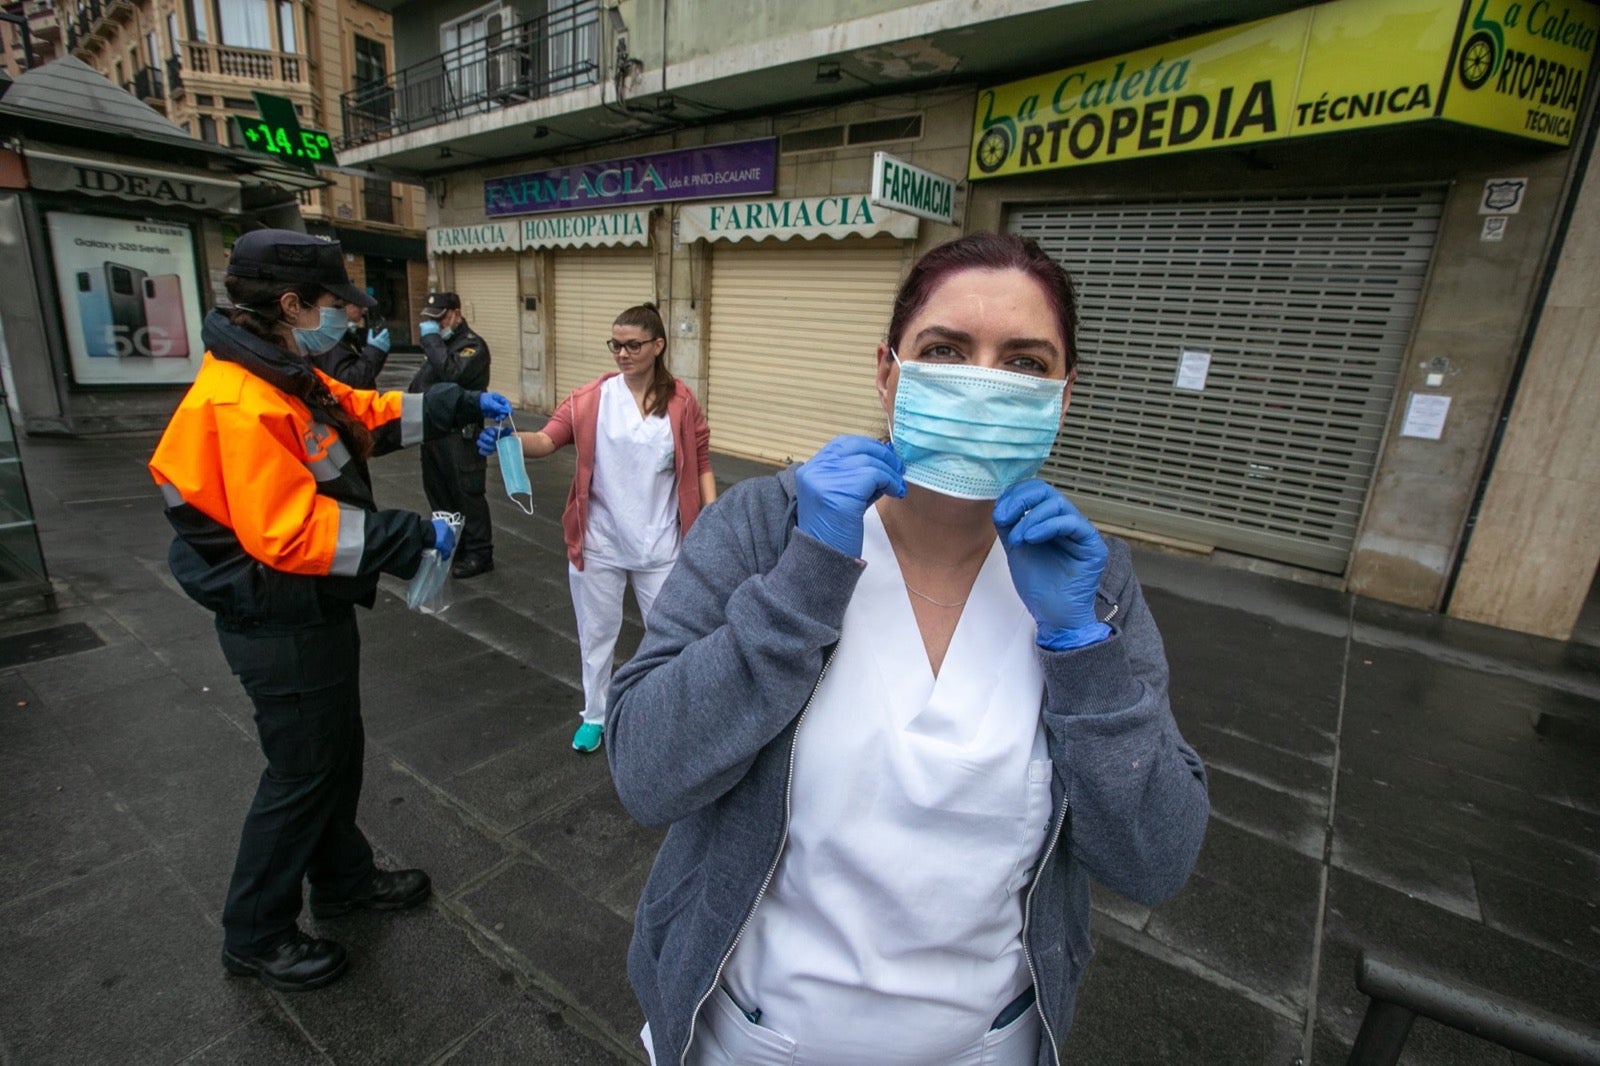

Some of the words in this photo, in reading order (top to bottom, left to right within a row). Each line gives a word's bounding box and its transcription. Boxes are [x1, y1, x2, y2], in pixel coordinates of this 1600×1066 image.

[1526, 0, 1593, 52] Caleta
[1052, 57, 1191, 115] Caleta
[1297, 83, 1431, 127] TÉCNICA
[1524, 104, 1572, 139] TÉCNICA
[73, 166, 206, 206] IDEAL
[486, 163, 667, 208] FARMACIA
[691, 172, 714, 186] PINTO
[714, 167, 761, 185] ESCALANTE
[882, 160, 952, 219] FARMACIA
[525, 211, 644, 241] HOMEOPATIA
[709, 196, 875, 232] FARMACIA
[74, 238, 116, 252] Galaxy
[139, 245, 170, 255] Series
[436, 223, 505, 247] FARMACIA
[104, 325, 173, 358] 5G
